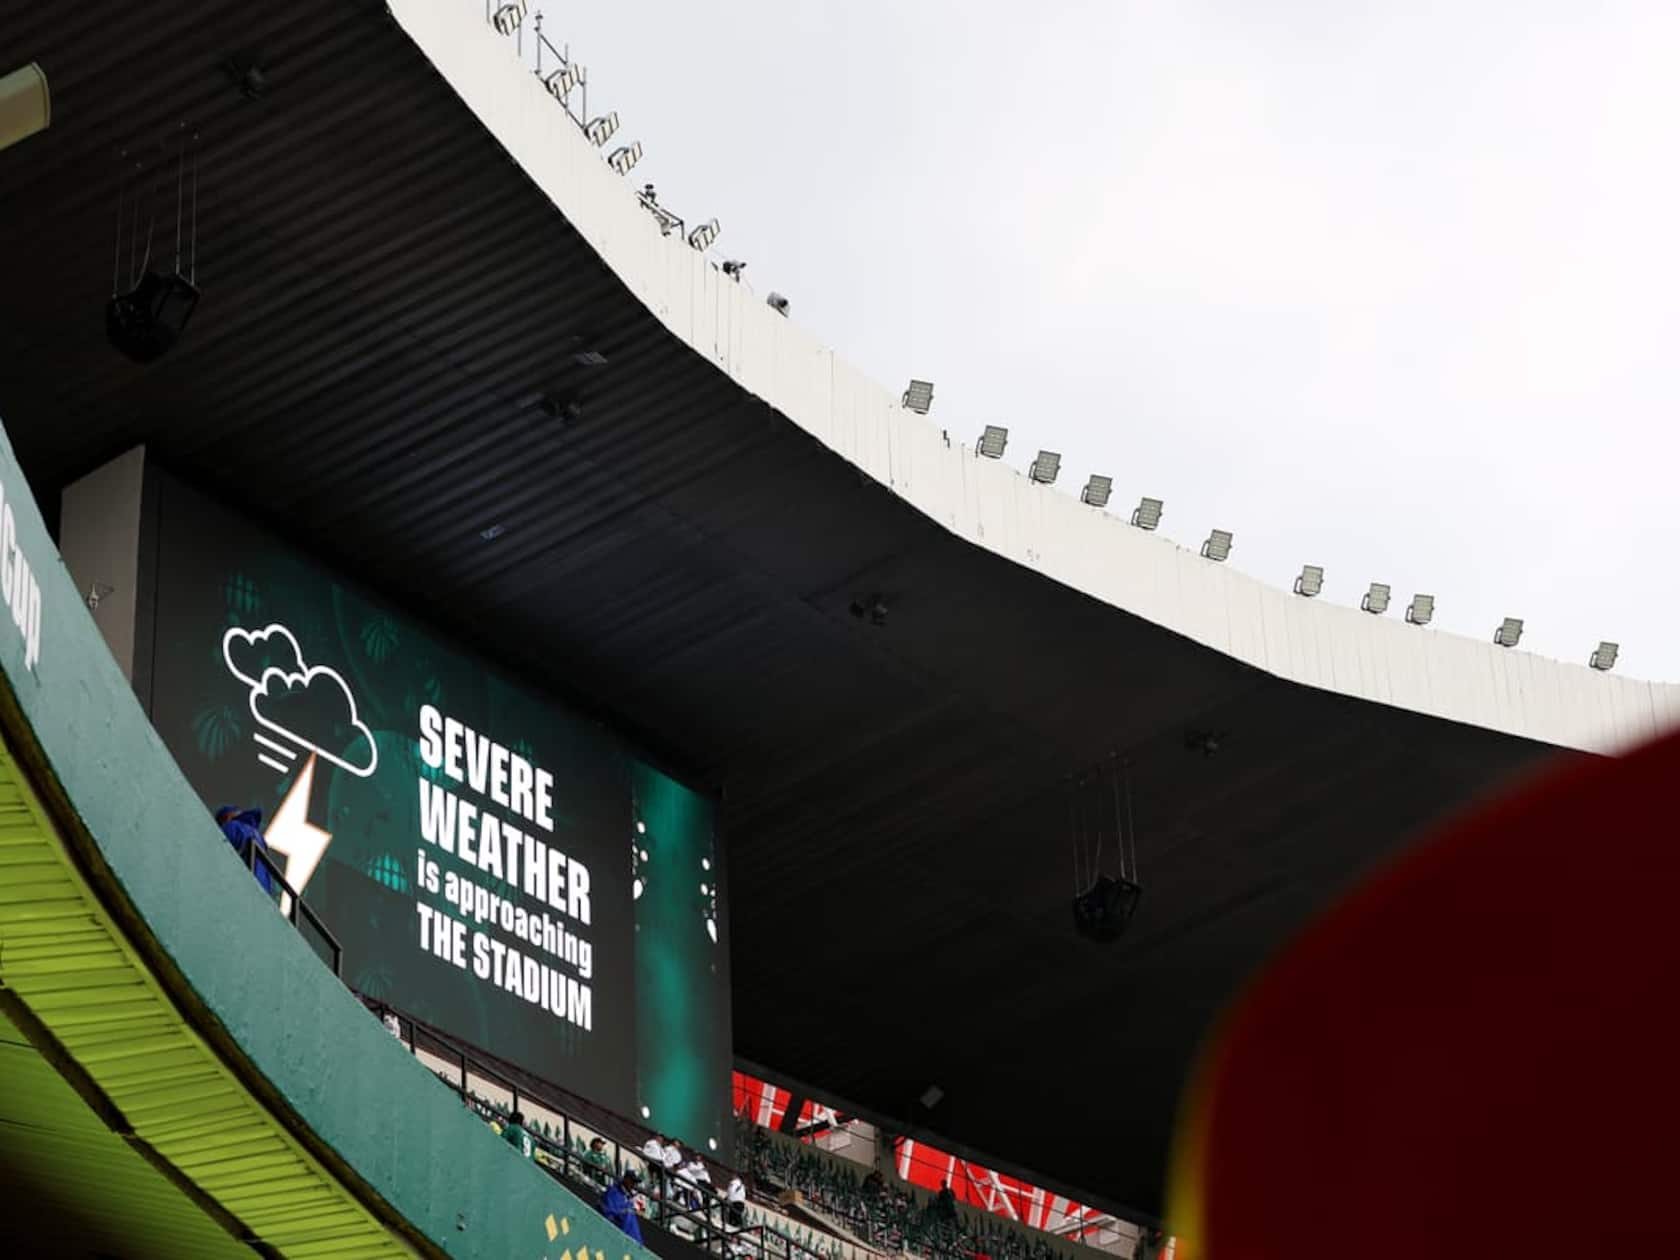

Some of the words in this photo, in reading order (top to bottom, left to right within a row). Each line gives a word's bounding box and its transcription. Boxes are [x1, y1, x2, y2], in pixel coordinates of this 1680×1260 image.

[1, 502, 42, 672] Cup
[419, 704, 554, 832] SEVERE
[417, 848, 440, 894] is
[444, 870, 593, 979] approaching
[419, 777, 591, 926] WEATHER
[416, 901, 467, 969] THE
[472, 931, 592, 1032] STADIUM
